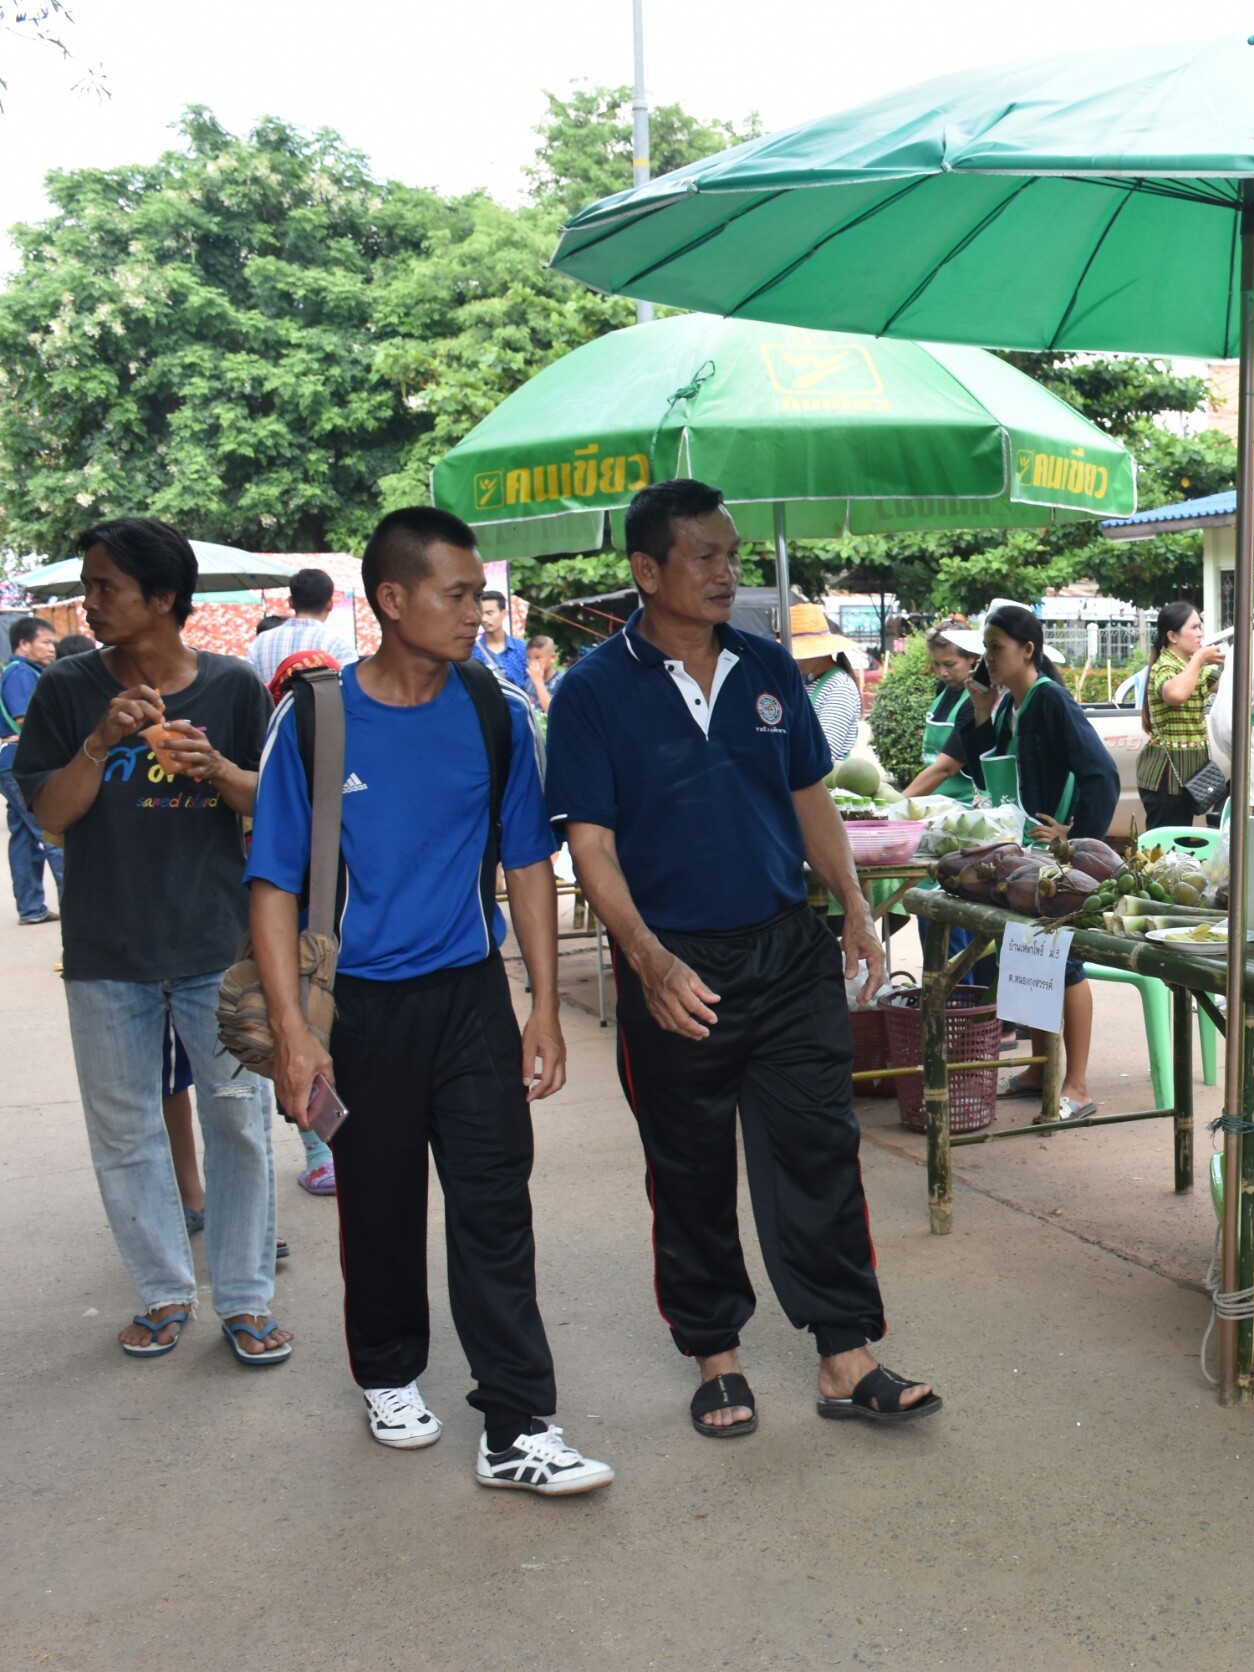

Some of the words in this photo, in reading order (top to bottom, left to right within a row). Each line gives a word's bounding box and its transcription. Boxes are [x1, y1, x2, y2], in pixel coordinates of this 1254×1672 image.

[506, 443, 649, 505] คนเขียว
[1104, 735, 1144, 751] Tig
